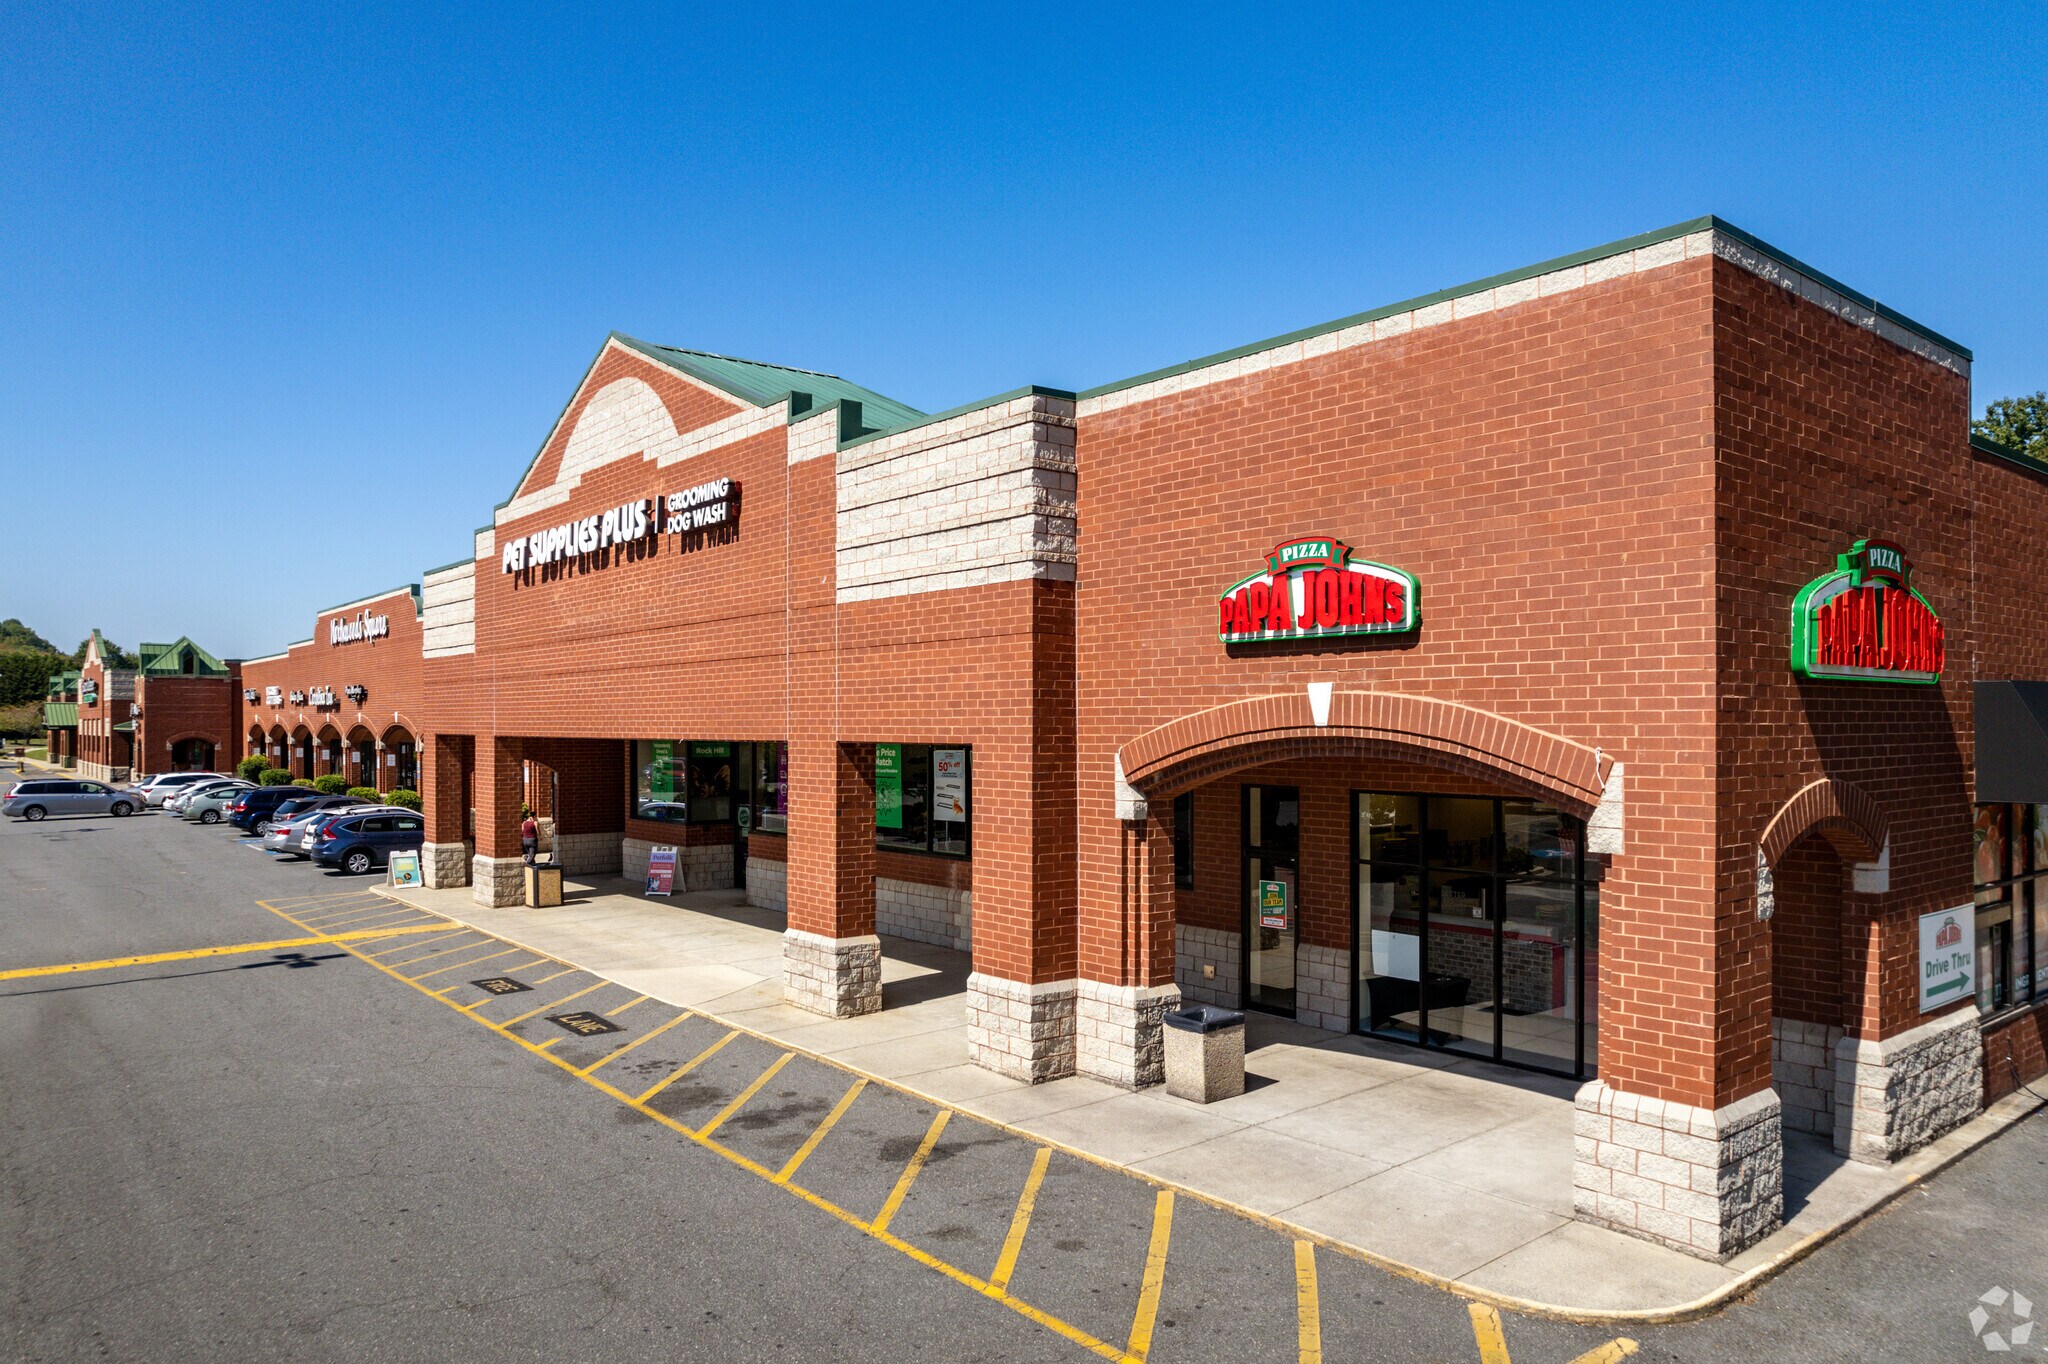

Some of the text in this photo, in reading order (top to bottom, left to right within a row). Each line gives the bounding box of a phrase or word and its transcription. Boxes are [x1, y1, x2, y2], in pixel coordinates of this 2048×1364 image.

[668, 477, 729, 512] GROOMING
[667, 502, 727, 535] DOG WASH
[502, 499, 648, 574] PET SUPPLIES PLUS
[1282, 543, 1328, 562] PIZZA
[1869, 548, 1901, 573] PIZZA
[1219, 574, 1292, 634] PAPA
[1817, 586, 1879, 668] PAPA
[881, 748, 896, 757] Price
[1926, 952, 1971, 978] Drive Thru
[559, 1015, 608, 1033] LANE
